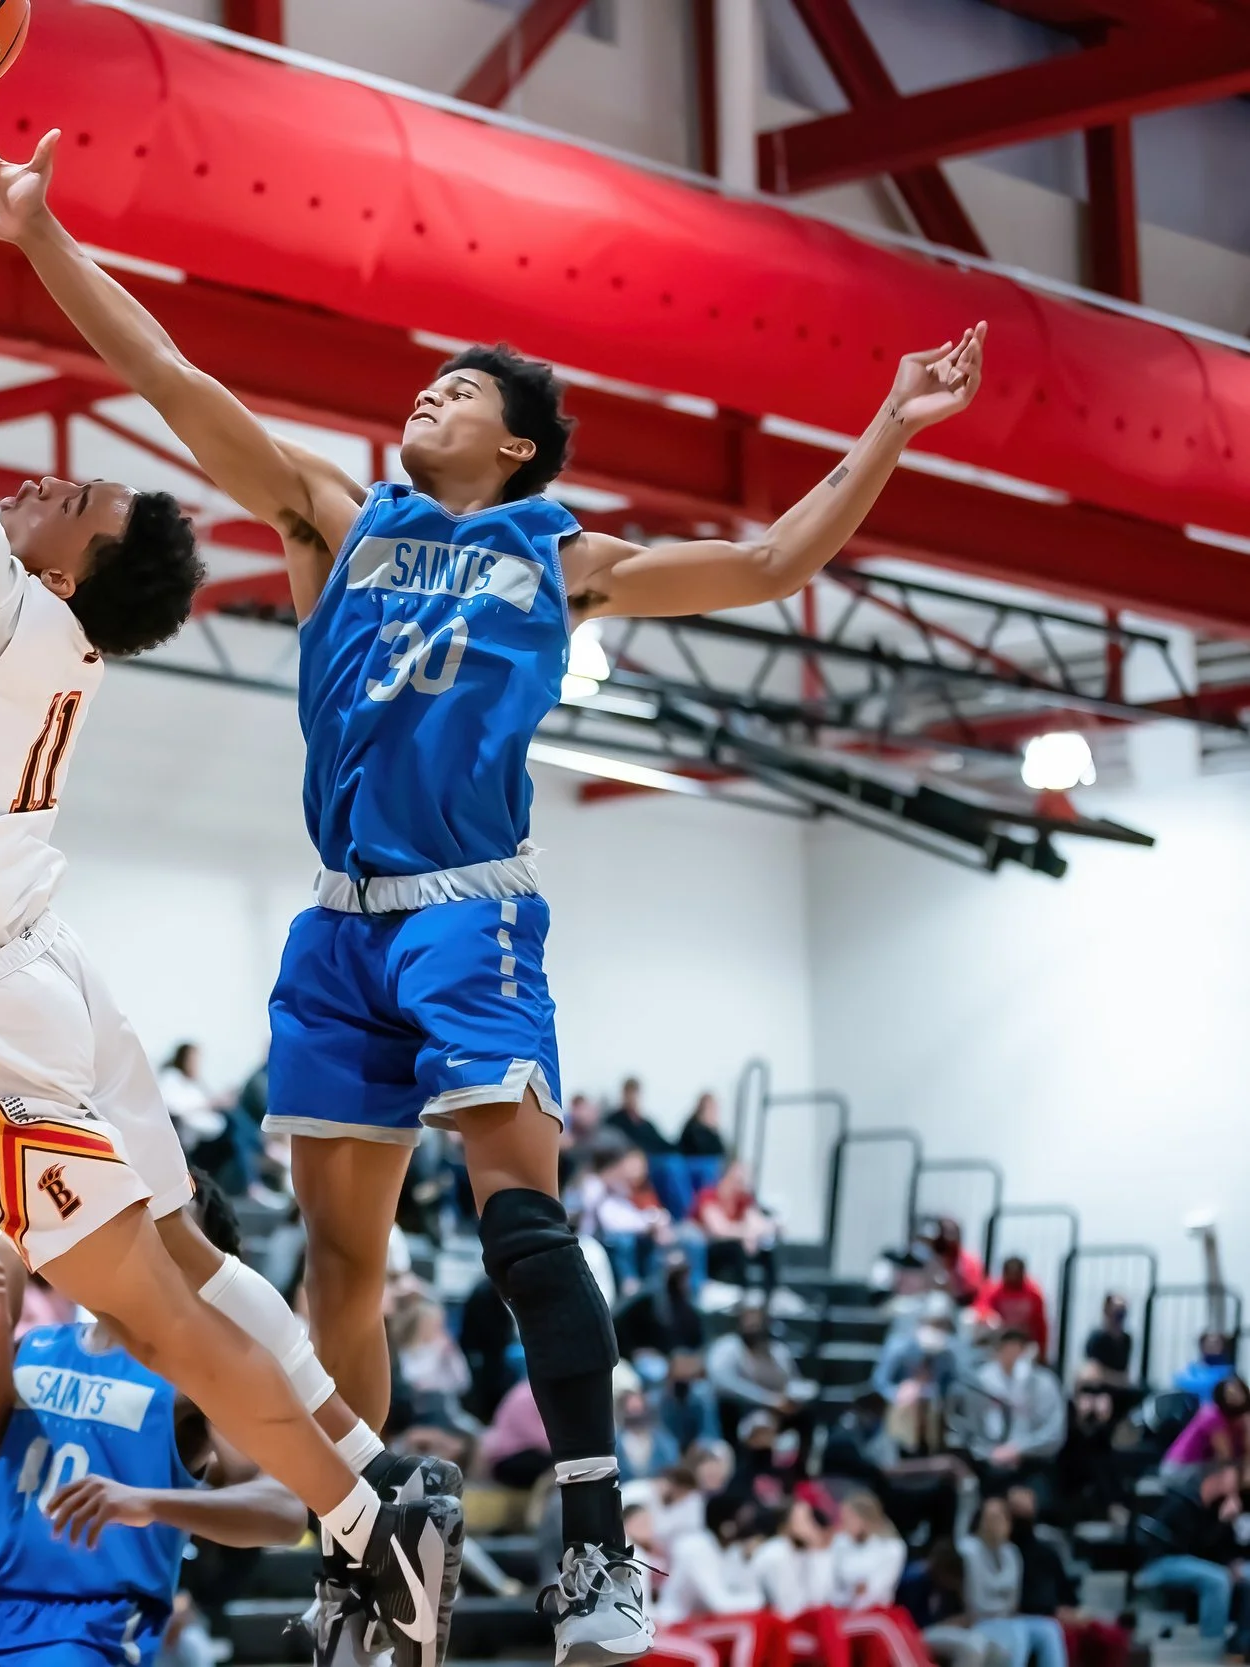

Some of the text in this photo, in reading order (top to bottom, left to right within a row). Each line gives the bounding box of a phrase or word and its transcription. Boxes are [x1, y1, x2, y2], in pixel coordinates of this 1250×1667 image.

[390, 542, 497, 594] SAINTS
[365, 615, 469, 702] 30
[8, 690, 83, 814] 11
[30, 1371, 113, 1416] SAINTS
